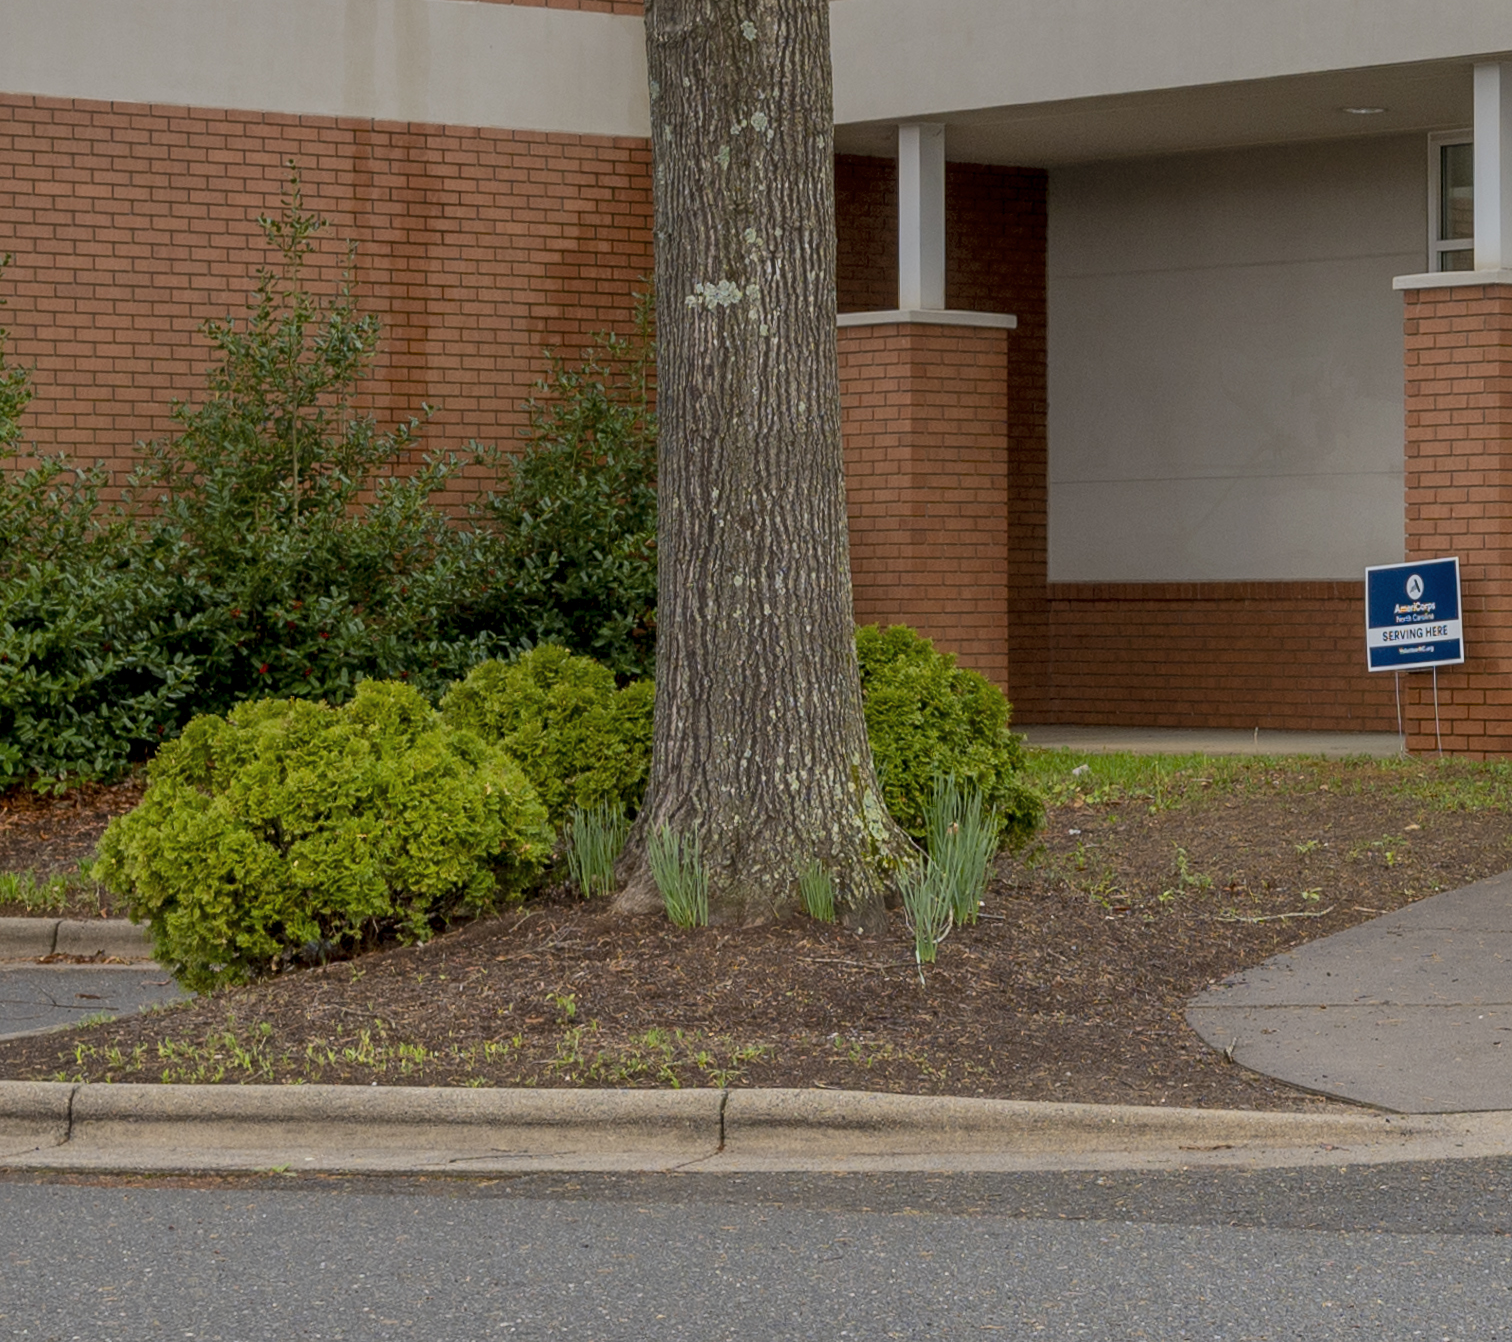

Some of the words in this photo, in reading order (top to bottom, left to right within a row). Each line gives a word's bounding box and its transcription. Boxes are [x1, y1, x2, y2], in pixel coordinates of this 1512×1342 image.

[1394, 602, 1435, 614] AmeriCorps
[1396, 615, 1411, 623] North
[1413, 613, 1434, 621] Carolina
[1383, 628, 1423, 641] SERVING
[1426, 625, 1448, 637] HERE
